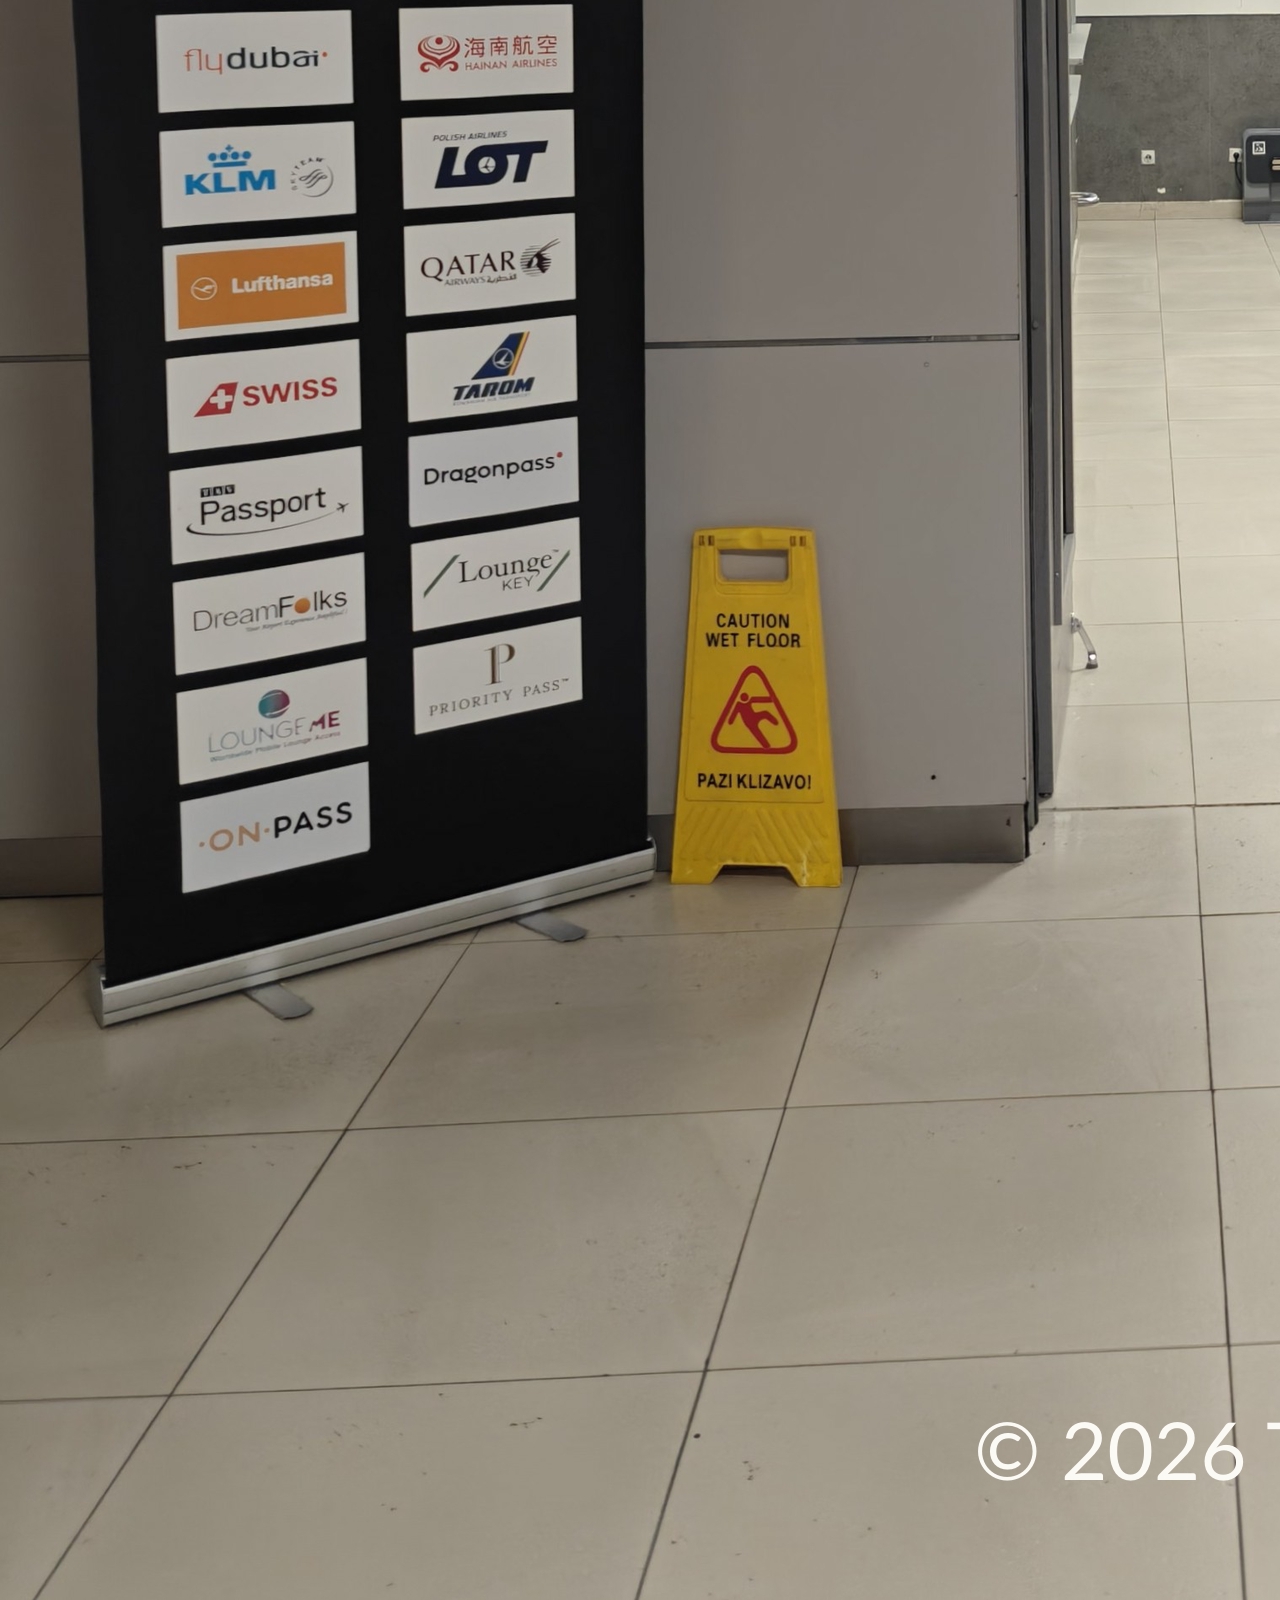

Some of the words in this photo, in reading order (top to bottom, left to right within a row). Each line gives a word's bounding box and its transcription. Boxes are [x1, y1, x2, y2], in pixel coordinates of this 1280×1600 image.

[464, 34, 558, 58] 海南航空
[183, 46, 319, 75] flydubai
[465, 61, 507, 71] HAINAN
[512, 58, 558, 68] AIRLINES
[433, 133, 466, 142] POLISH
[468, 130, 507, 140] AIRLINES
[434, 140, 548, 189] LOT
[184, 169, 276, 195] KLM
[420, 250, 516, 282] QATAR
[231, 271, 333, 295] Lufthansa
[444, 275, 486, 286] AIRWAYS
[243, 377, 338, 406] SWISS
[453, 377, 535, 401] TAROM
[423, 455, 556, 486] Dragonpass
[200, 487, 326, 526] Passport
[458, 553, 553, 584] Lounge
[502, 575, 535, 591] KEY
[193, 590, 348, 632] DreamFolks
[716, 613, 790, 629] CAUTION
[706, 632, 738, 648] WET
[747, 633, 801, 648] FLOOR
[484, 643, 516, 686] P
[429, 689, 513, 717] PRIORITY
[697, 773, 733, 789] PAZI
[737, 774, 813, 790] KLIZAVO!
